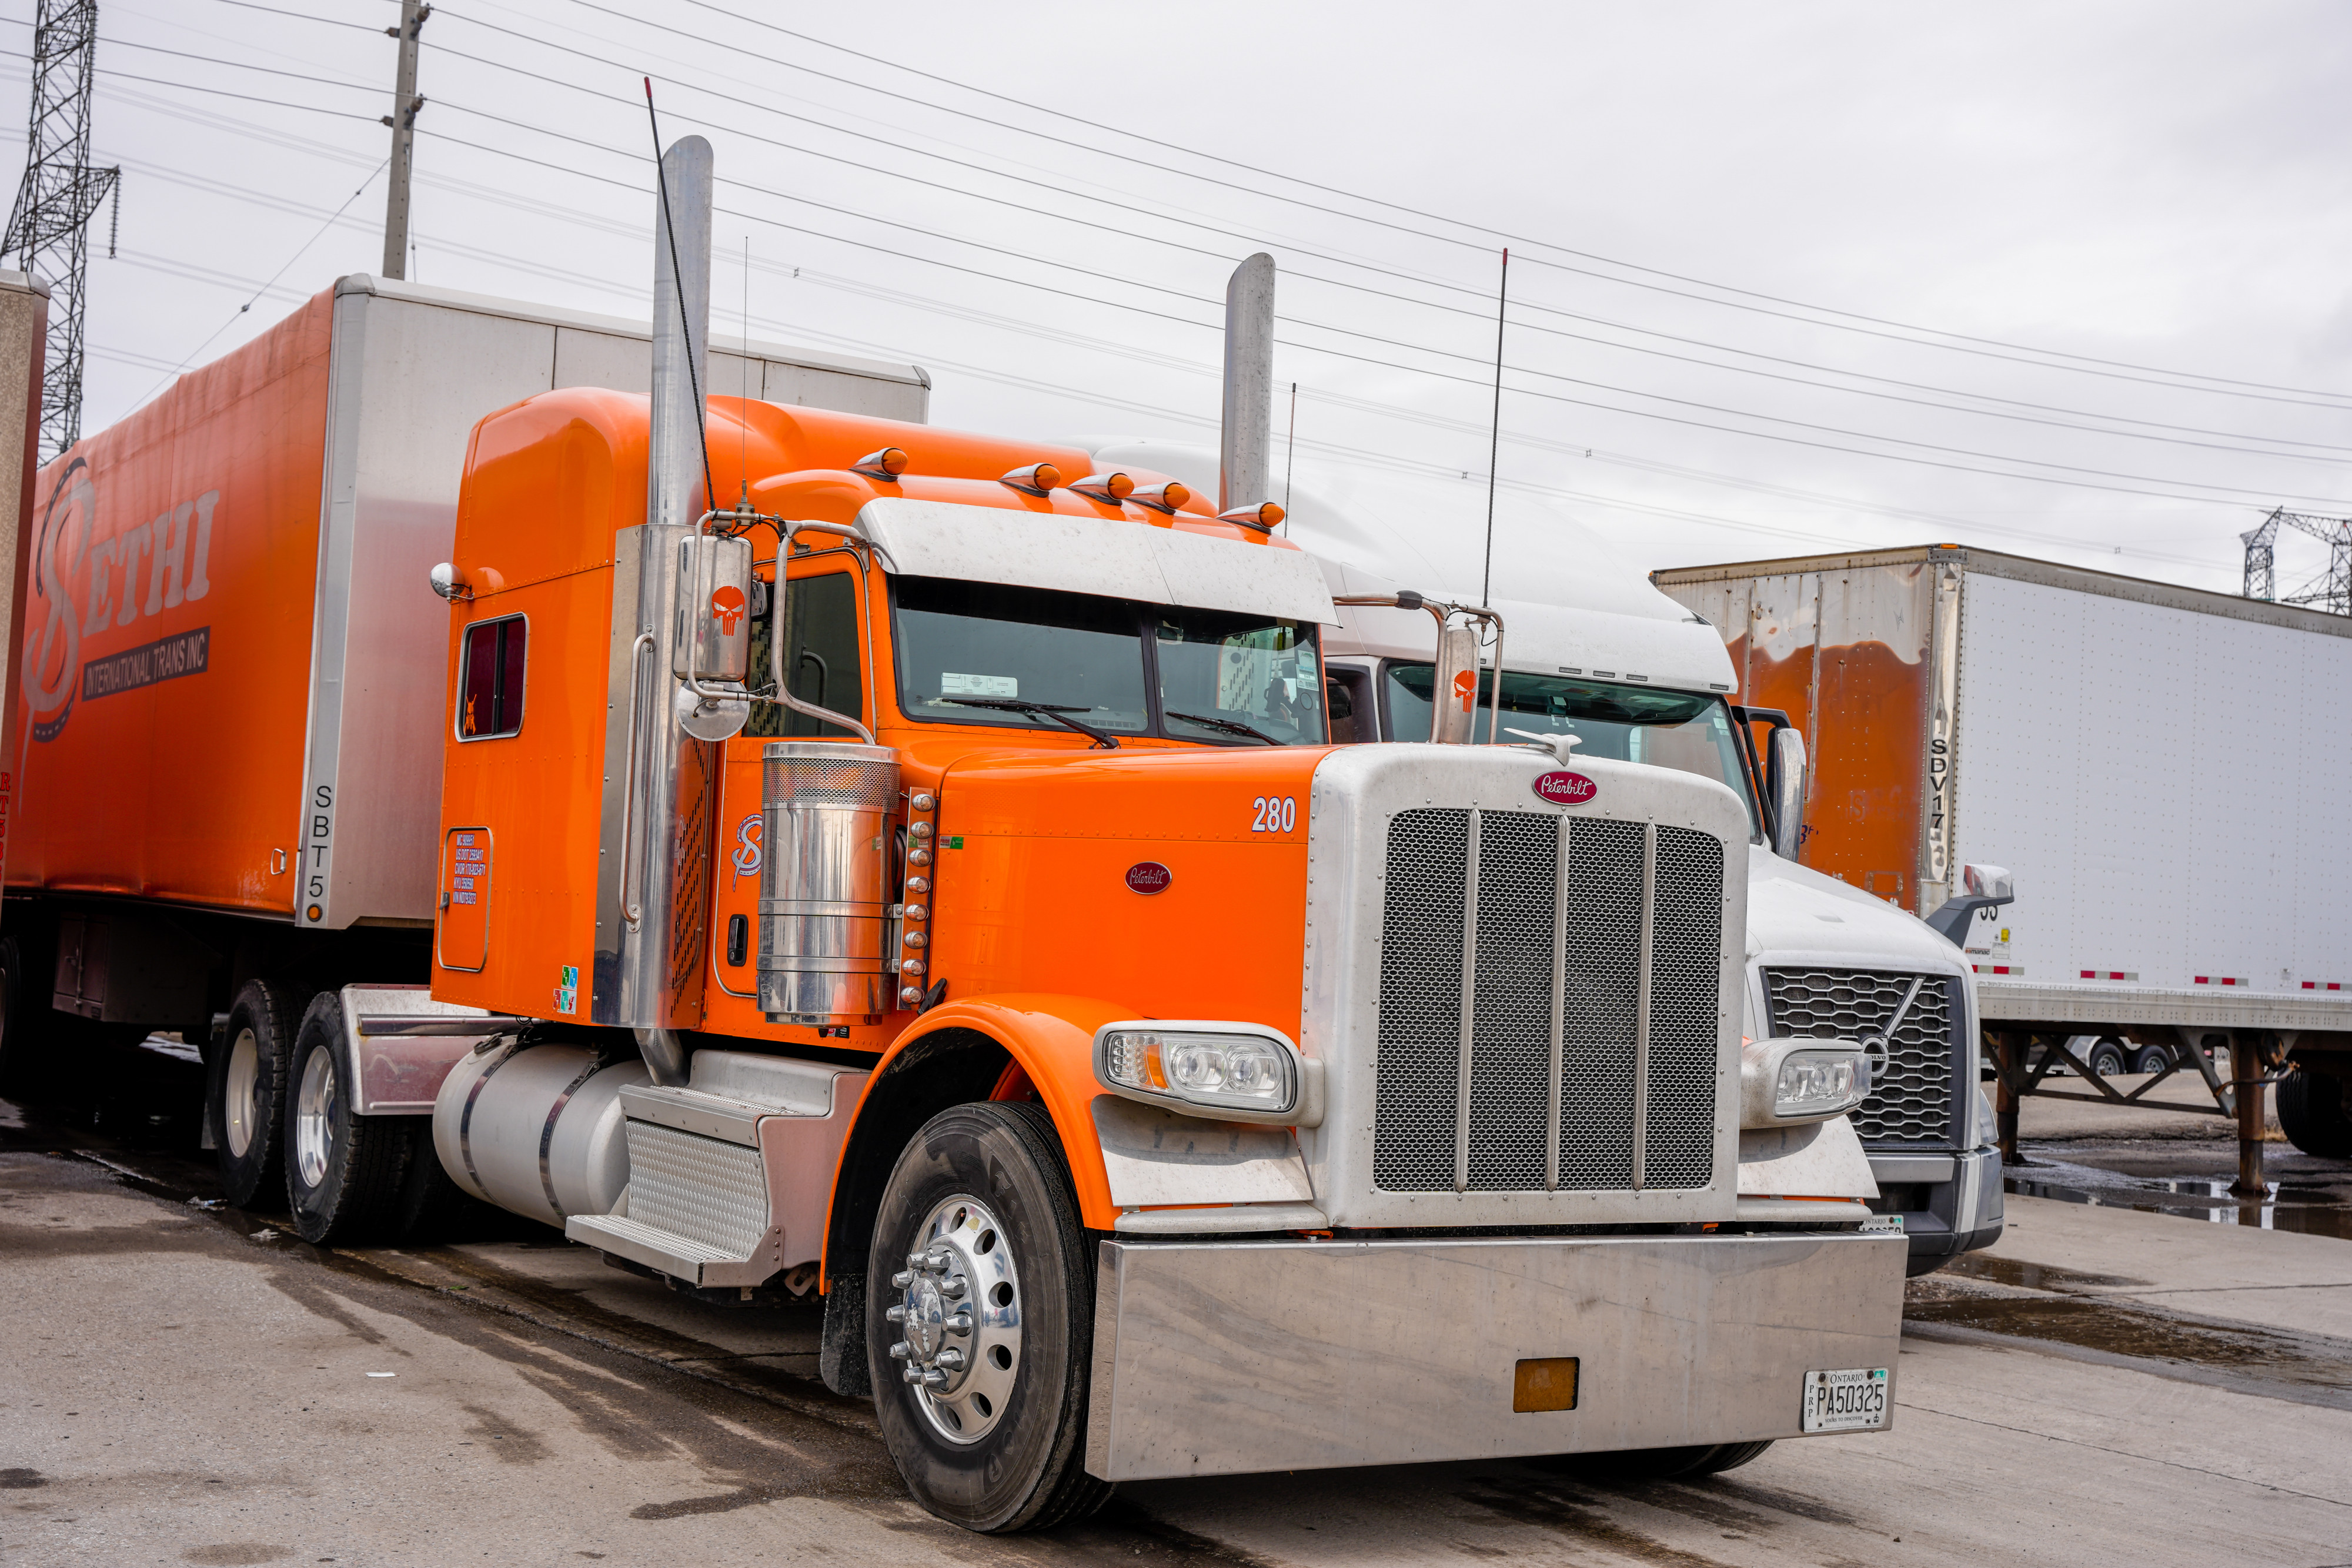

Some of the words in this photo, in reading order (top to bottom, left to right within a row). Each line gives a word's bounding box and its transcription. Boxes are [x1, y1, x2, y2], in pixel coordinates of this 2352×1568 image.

[21, 477, 220, 713] SETHI
[86, 651, 151, 696] INTERNATIONAL
[153, 639, 186, 679] TRANS
[186, 633, 205, 670] INC
[1541, 775, 1592, 795] Peterbilt
[1930, 739, 1947, 828] SDV17
[1251, 796, 1296, 833] 280
[309, 785, 331, 897] SBT5
[456, 834, 463, 846] MC
[456, 848, 462, 861] US
[455, 862, 465, 875] CVOR
[1130, 867, 1167, 885] Peterbilt
[453, 877, 462, 889] KYU
[1830, 1373, 1863, 1384] ONTARIO
[1817, 1383, 1884, 1415] PA50325
